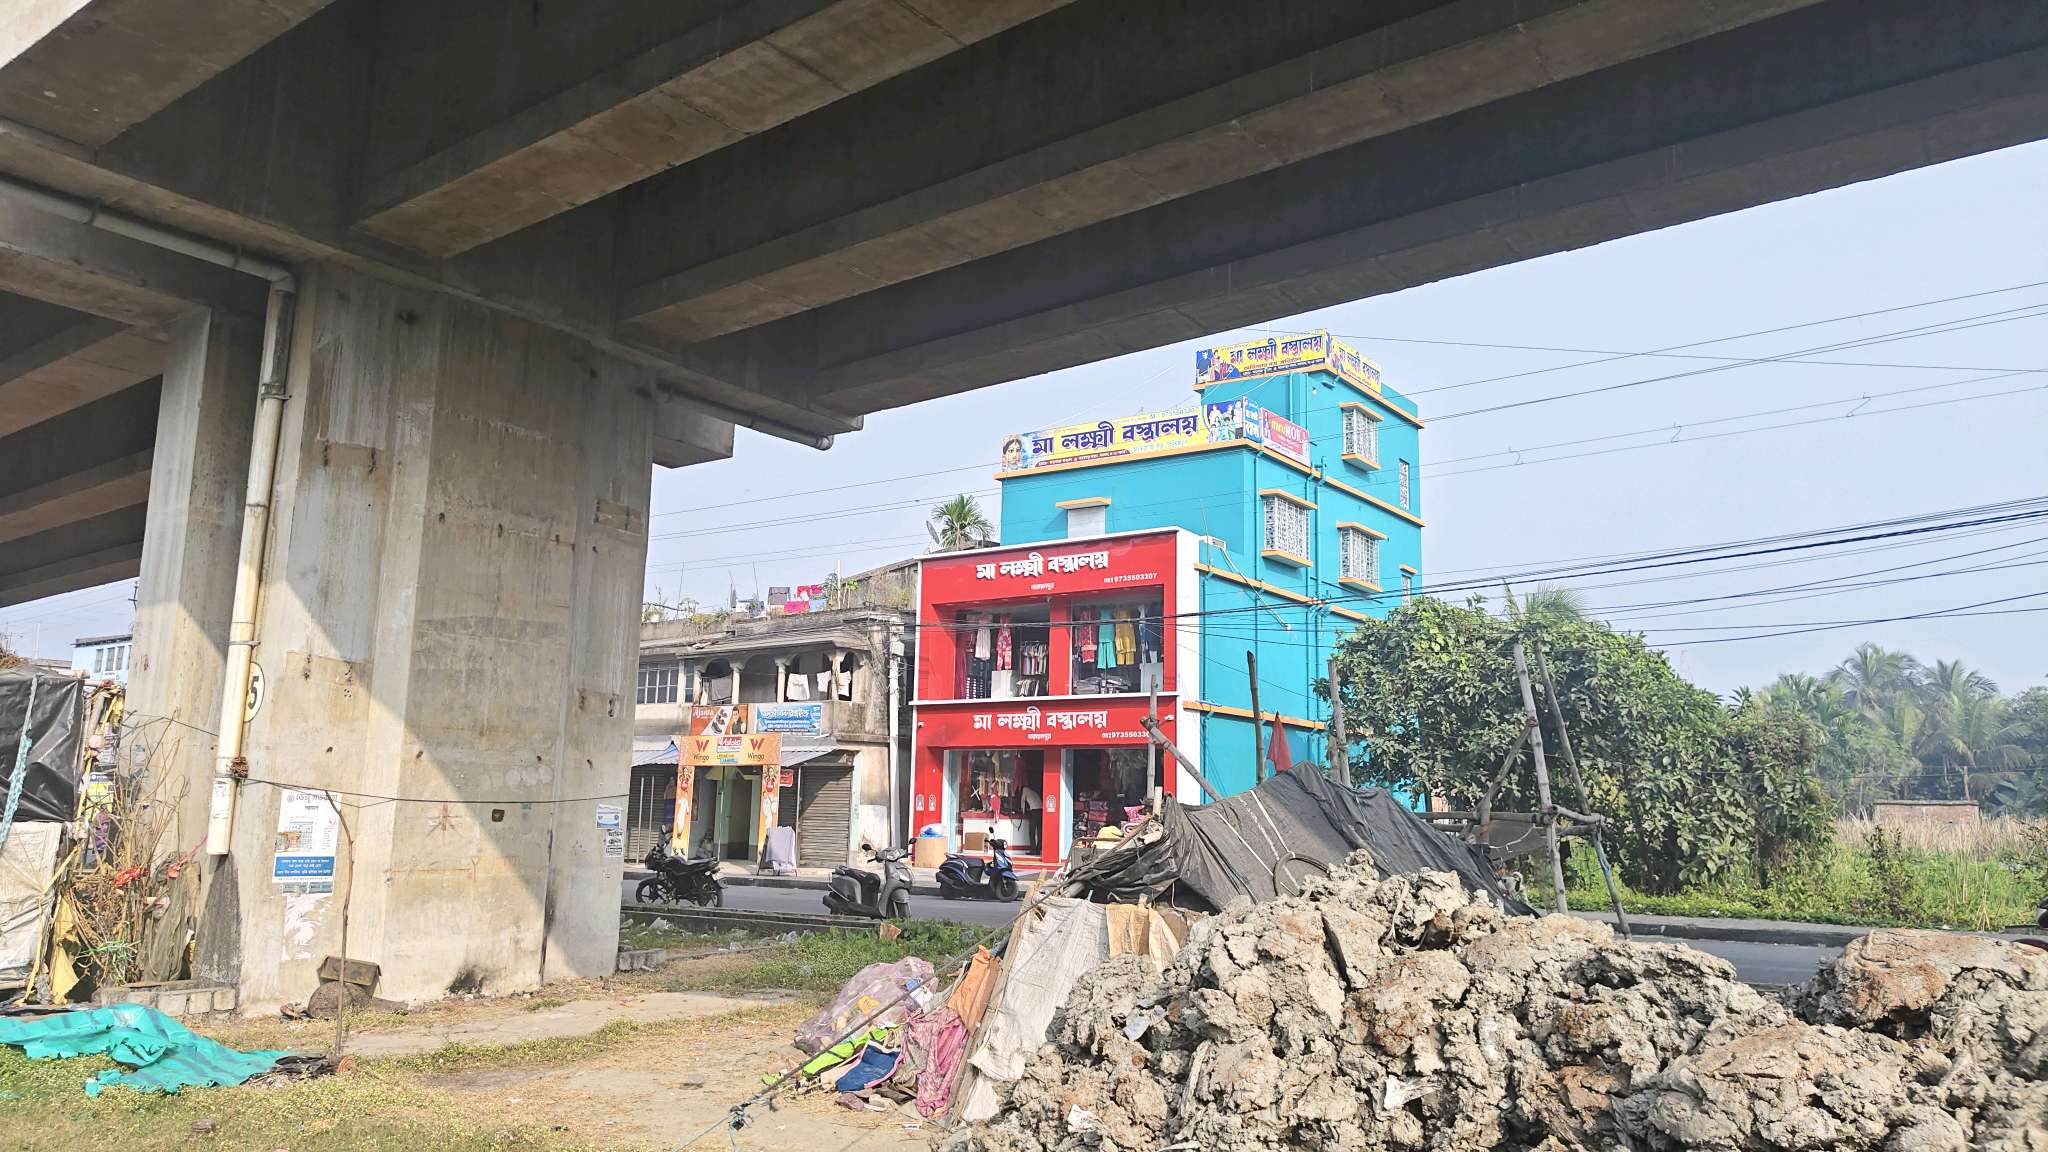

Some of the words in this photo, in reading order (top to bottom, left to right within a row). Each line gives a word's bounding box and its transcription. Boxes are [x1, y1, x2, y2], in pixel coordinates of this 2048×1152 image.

[1230, 350, 1243, 364] মা
[1247, 338, 1277, 362] লক্ষ্মী
[1281, 336, 1322, 356] বস্ত্রালয়
[1032, 437, 1054, 454] মা
[1061, 421, 1114, 449] লক্ষ্মী
[1122, 415, 1199, 441] বস্ত্রালয়
[976, 563, 996, 580] মা
[1000, 552, 1044, 577] লক্ষ্মী
[1048, 551, 1109, 573] বস্ত্রালয়
[973, 714, 992, 730] মা
[997, 706, 1041, 731] লক্ষ্মী
[1046, 711, 1108, 730] বস্ত্রালয়
